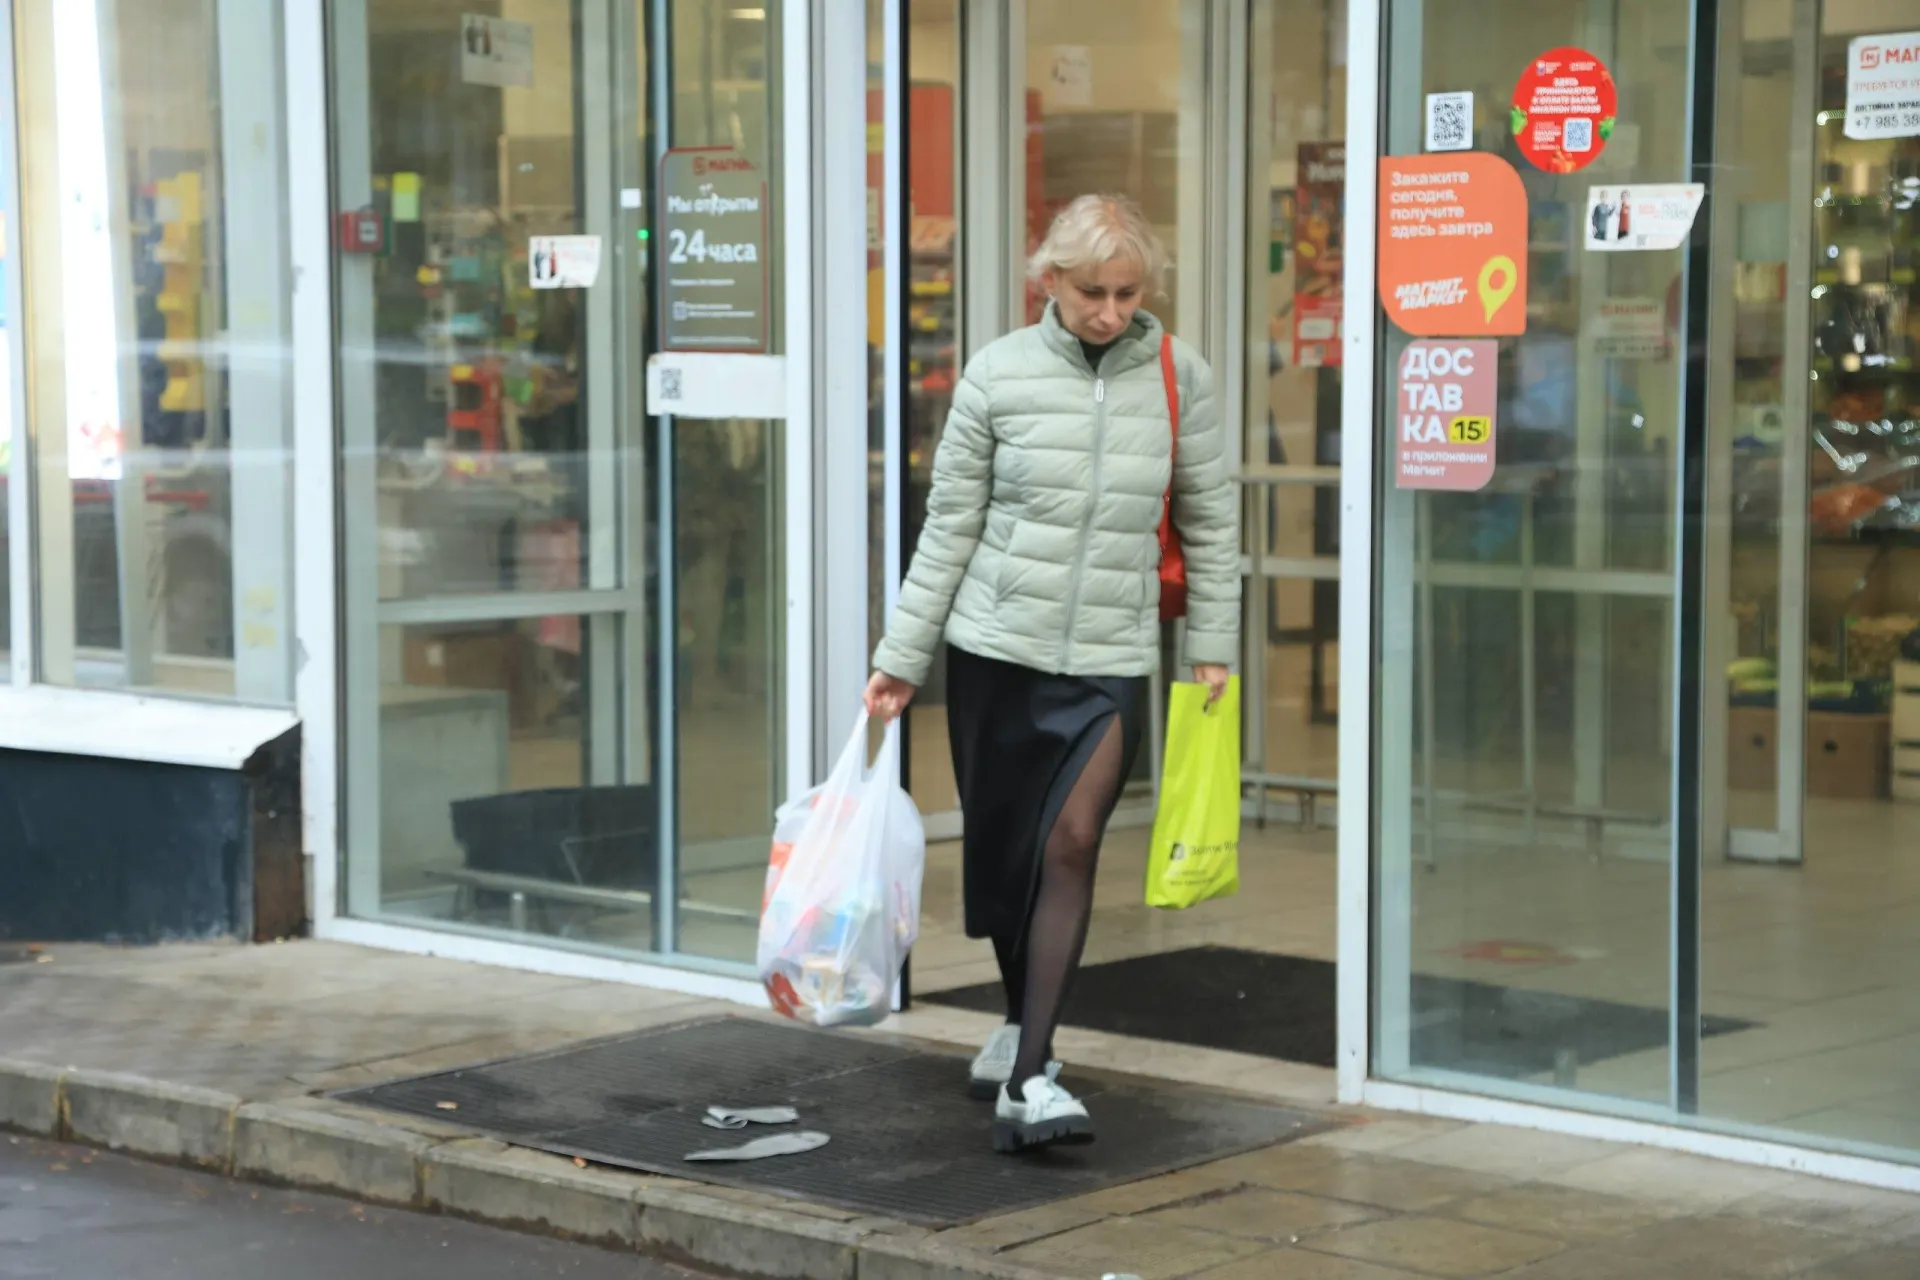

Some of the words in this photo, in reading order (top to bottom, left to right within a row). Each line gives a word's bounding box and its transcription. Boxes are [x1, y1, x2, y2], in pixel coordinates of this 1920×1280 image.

[1855, 116, 1871, 129] +7
[1391, 171, 1470, 187] Закажите
[667, 195, 693, 213] Мы
[1390, 206, 1465, 222] получите
[1391, 224, 1436, 239] здесь
[1438, 221, 1493, 239] завтра
[669, 228, 706, 263] 24
[707, 243, 758, 263] часа
[1402, 347, 1475, 381] ДОС
[1403, 383, 1463, 411] ТАВ
[1403, 414, 1447, 443] КА
[1454, 420, 1482, 441] 15
[1412, 450, 1488, 464] приложении
[1403, 464, 1446, 476] Магнит
